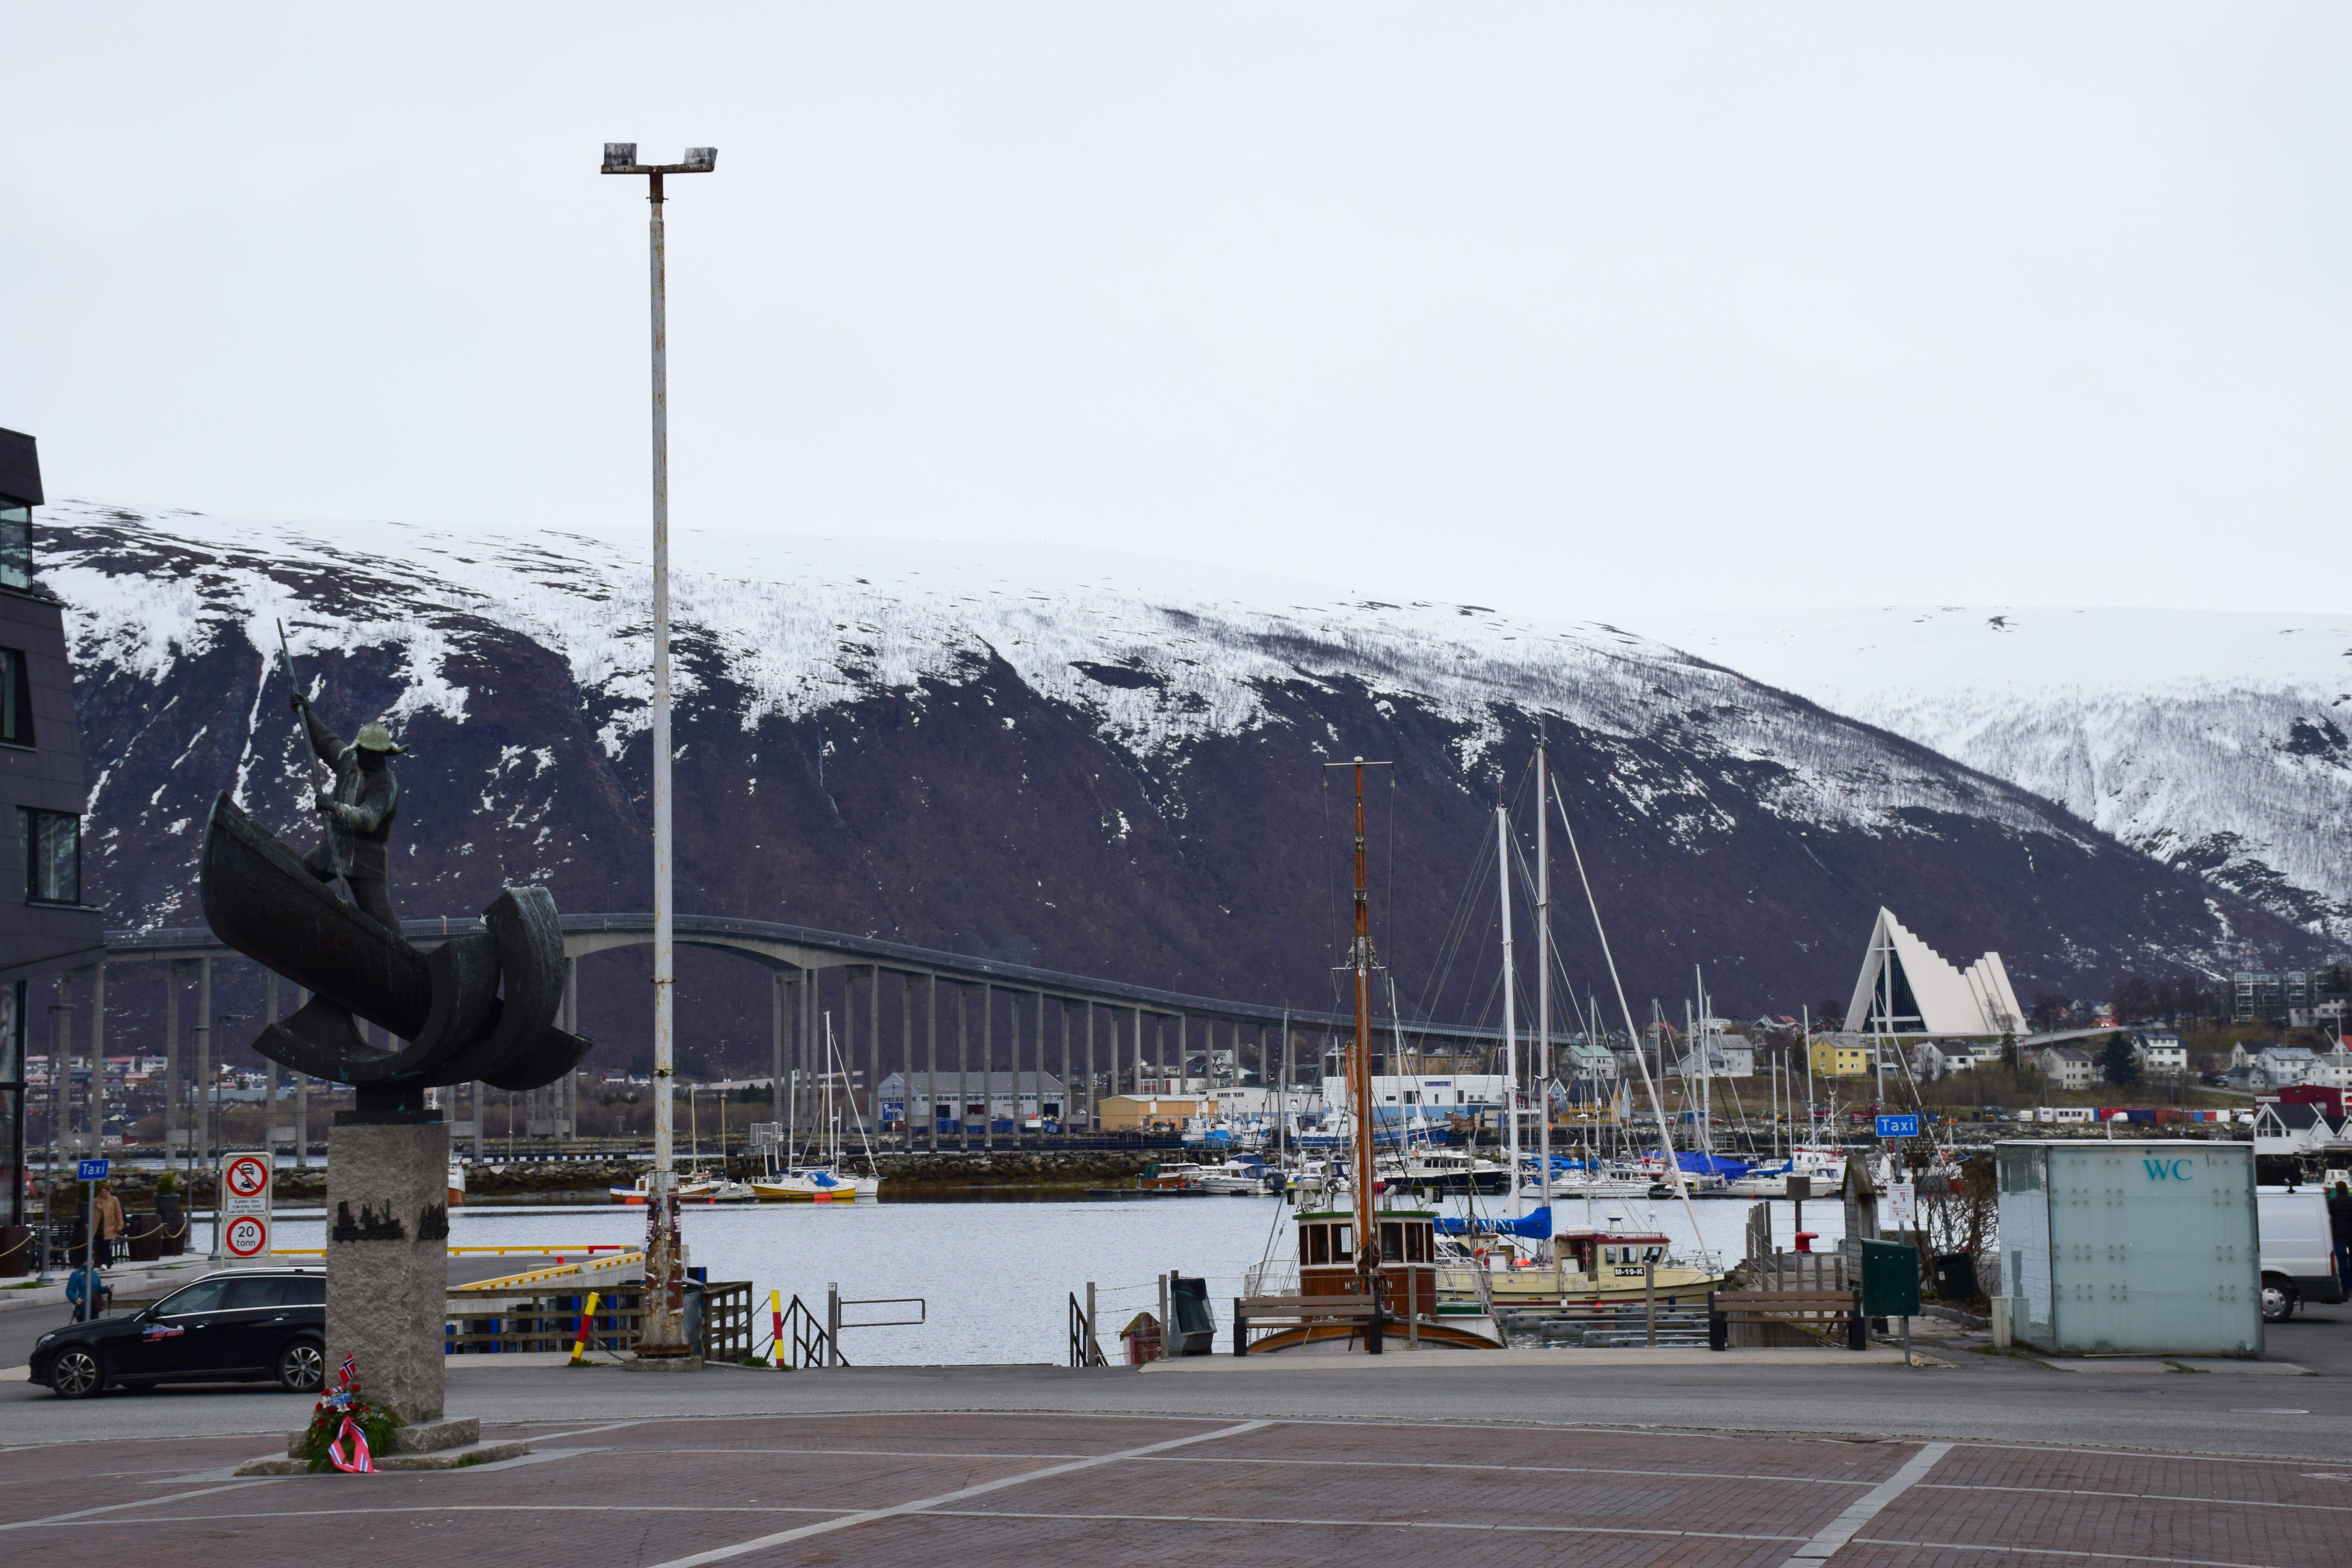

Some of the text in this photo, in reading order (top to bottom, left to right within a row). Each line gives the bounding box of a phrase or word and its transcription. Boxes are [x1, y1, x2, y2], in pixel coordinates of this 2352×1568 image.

[1881, 1118, 1913, 1131] Taxi
[83, 1163, 105, 1175] Taxi
[2143, 1159, 2193, 1180] WC
[238, 1226, 254, 1237] 20
